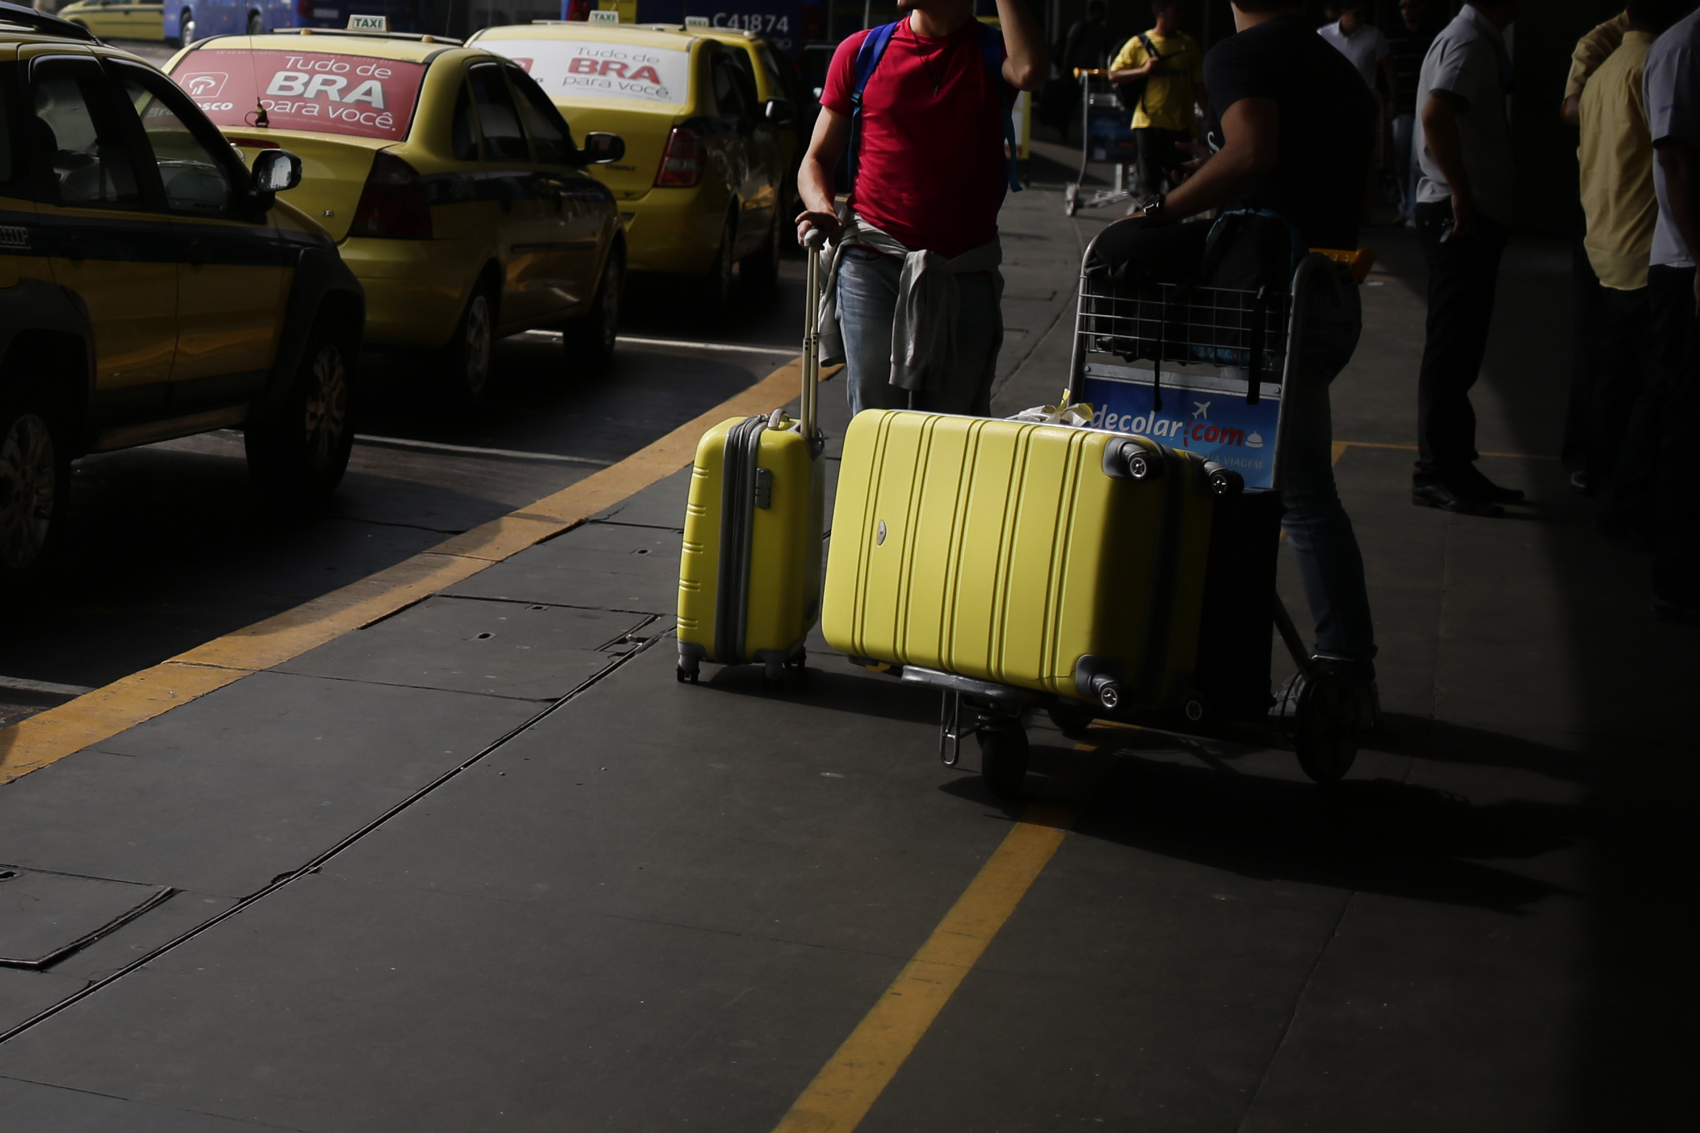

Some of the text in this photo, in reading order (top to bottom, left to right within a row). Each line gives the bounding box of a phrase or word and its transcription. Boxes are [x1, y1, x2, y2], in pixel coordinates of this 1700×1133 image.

[354, 18, 382, 29] TAXI
[594, 13, 616, 21] TAXI
[713, 12, 789, 34] C41874
[576, 46, 660, 64] Tudo de
[284, 56, 350, 73] Tudo
[356, 63, 392, 79] de
[567, 57, 661, 85] BRA
[265, 71, 385, 109] BRA
[562, 76, 611, 90] para
[618, 79, 672, 99] você.
[328, 112, 396, 131] você.
[1224, 457, 1263, 470] VIAGEM
